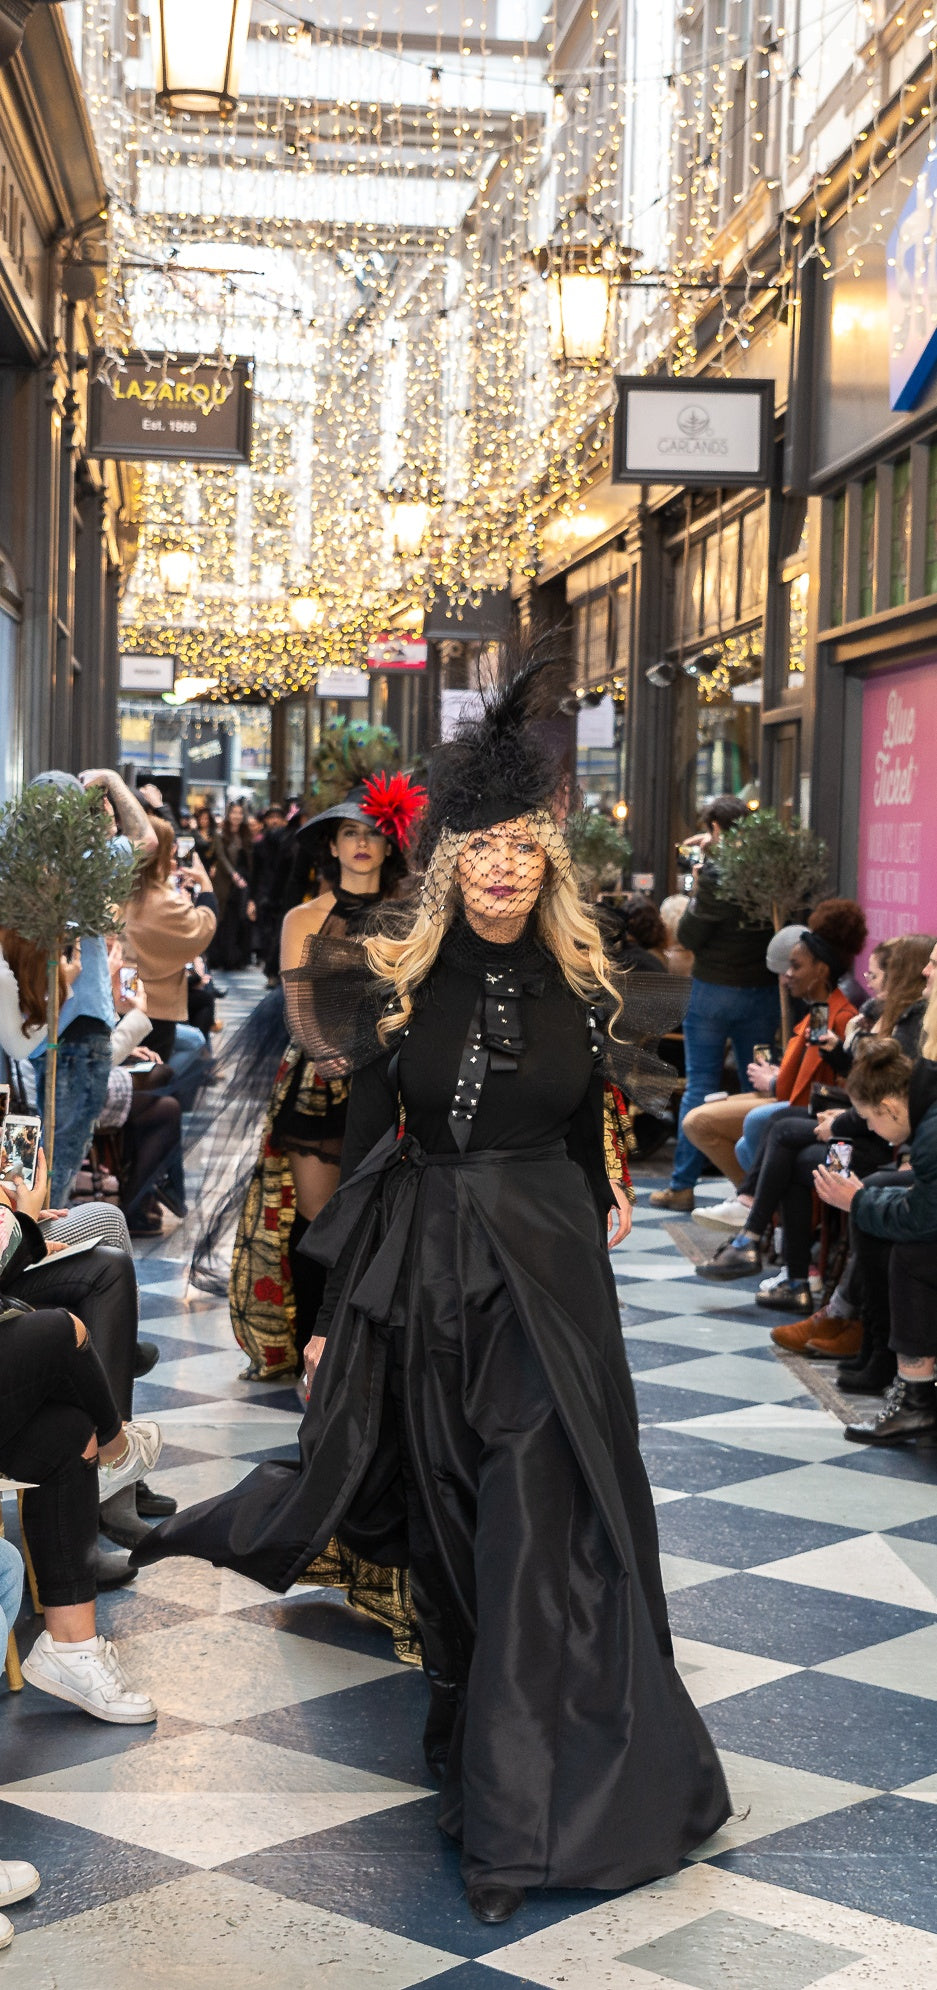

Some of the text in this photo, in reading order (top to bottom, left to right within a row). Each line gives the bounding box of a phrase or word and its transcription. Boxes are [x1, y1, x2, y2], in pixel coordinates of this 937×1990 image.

[113, 380, 227, 405] LAZAROU
[141, 418, 166, 431] Est.
[657, 438, 729, 455] GARLANDS
[883, 689, 916, 748] Blue
[873, 751, 917, 807] Ticket
